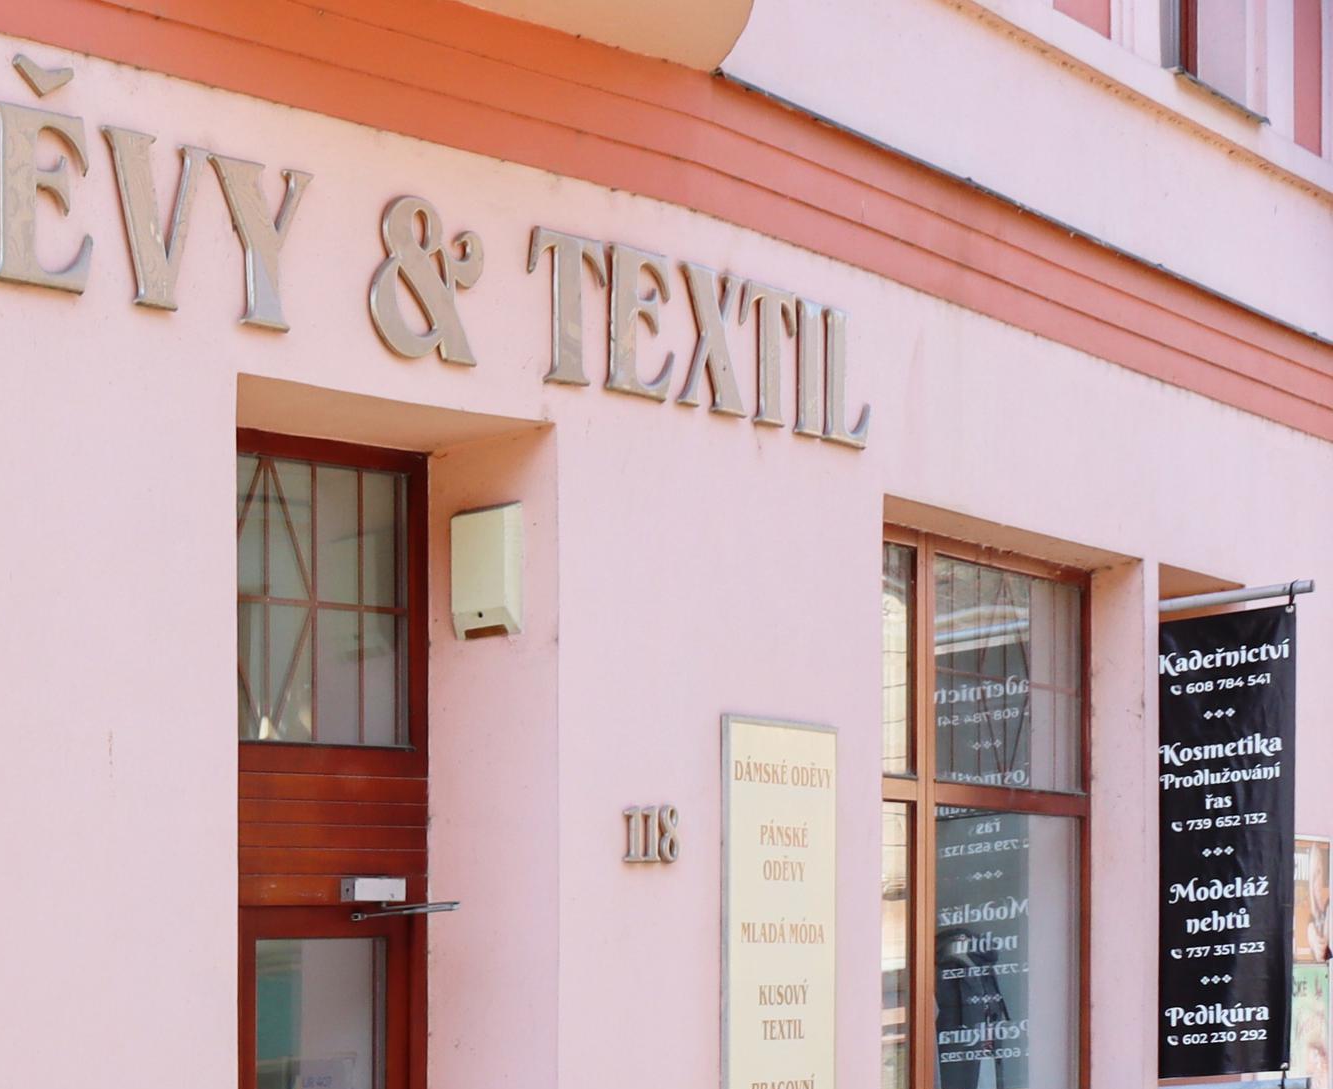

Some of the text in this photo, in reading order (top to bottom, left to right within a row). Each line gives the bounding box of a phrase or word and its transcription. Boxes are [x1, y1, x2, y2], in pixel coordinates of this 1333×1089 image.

[368, 196, 485, 368] &
[527, 224, 873, 451] TEXTIL
[1159, 639, 1290, 676] Kadeřnictví
[1186, 673, 1271, 694] 608 784 541
[1159, 733, 1282, 766] Kosmetika
[734, 755, 834, 789] DÁMSKÉ ODĚVY
[1160, 762, 1281, 790] Prodlužování
[1205, 794, 1232, 810] řas
[621, 805, 679, 864] 118
[759, 819, 809, 848] PÁNSKÉ
[1186, 813, 1268, 831] 739 652 132
[763, 855, 805, 882] ODĚVY
[1169, 876, 1269, 904] Modeláž
[741, 917, 825, 944] MLADÁ MÓDA
[1186, 908, 1251, 934] nehtů
[1186, 942, 1265, 958] 737 351 523
[758, 979, 809, 1006] KUSOVÝ
[1165, 1003, 1269, 1027] Pedikúra
[762, 1018, 805, 1040] TEXTIL
[1182, 1029, 1267, 1045] 602 230 292
